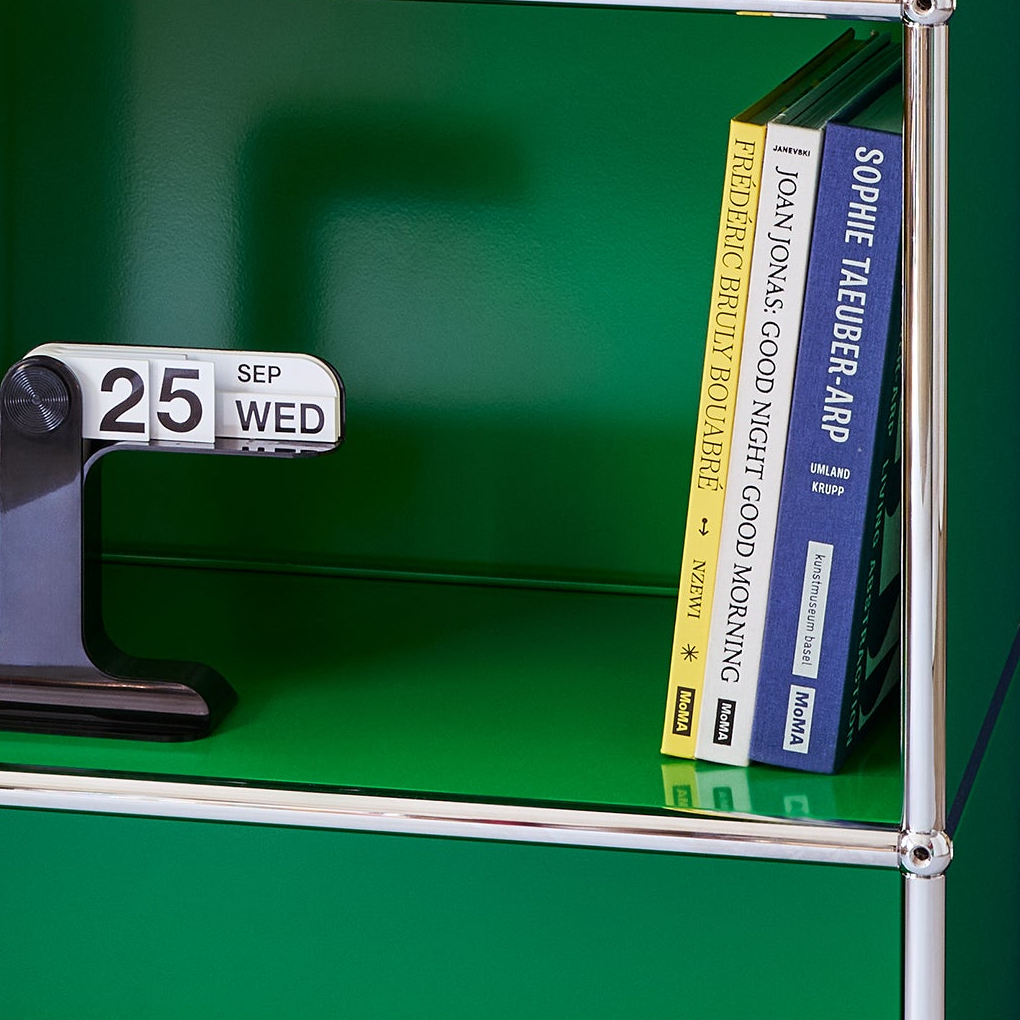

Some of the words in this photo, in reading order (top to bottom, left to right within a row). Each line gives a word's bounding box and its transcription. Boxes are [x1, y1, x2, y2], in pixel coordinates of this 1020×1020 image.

[772, 145, 811, 157] JANEVSKI
[722, 139, 757, 270] FRÉDÉRIC
[774, 166, 799, 232] JOAN
[844, 146, 884, 248] SOPHIE
[763, 232, 791, 314] JONAS:
[712, 276, 741, 362] BRULY
[821, 257, 871, 443] TAEUBER-ARP
[237, 364, 281, 384] SEP
[755, 321, 781, 394] GOOD
[99, 367, 204, 433] 25
[235, 400, 325, 434] WED
[698, 365, 731, 491] BOUABRÉ
[745, 400, 772, 480] NIGHT
[810, 462, 851, 480] UMLAND
[736, 485, 761, 558] GOOD
[811, 481, 845, 497] KRUPP
[687, 559, 707, 619] NZEWI
[806, 553, 826, 632] kunstmuseum
[720, 563, 752, 683] MORNING
[801, 635, 816, 666] basel
[675, 690, 692, 732] MoMA
[717, 702, 732, 741] MoMA
[789, 691, 810, 746] MoMA
